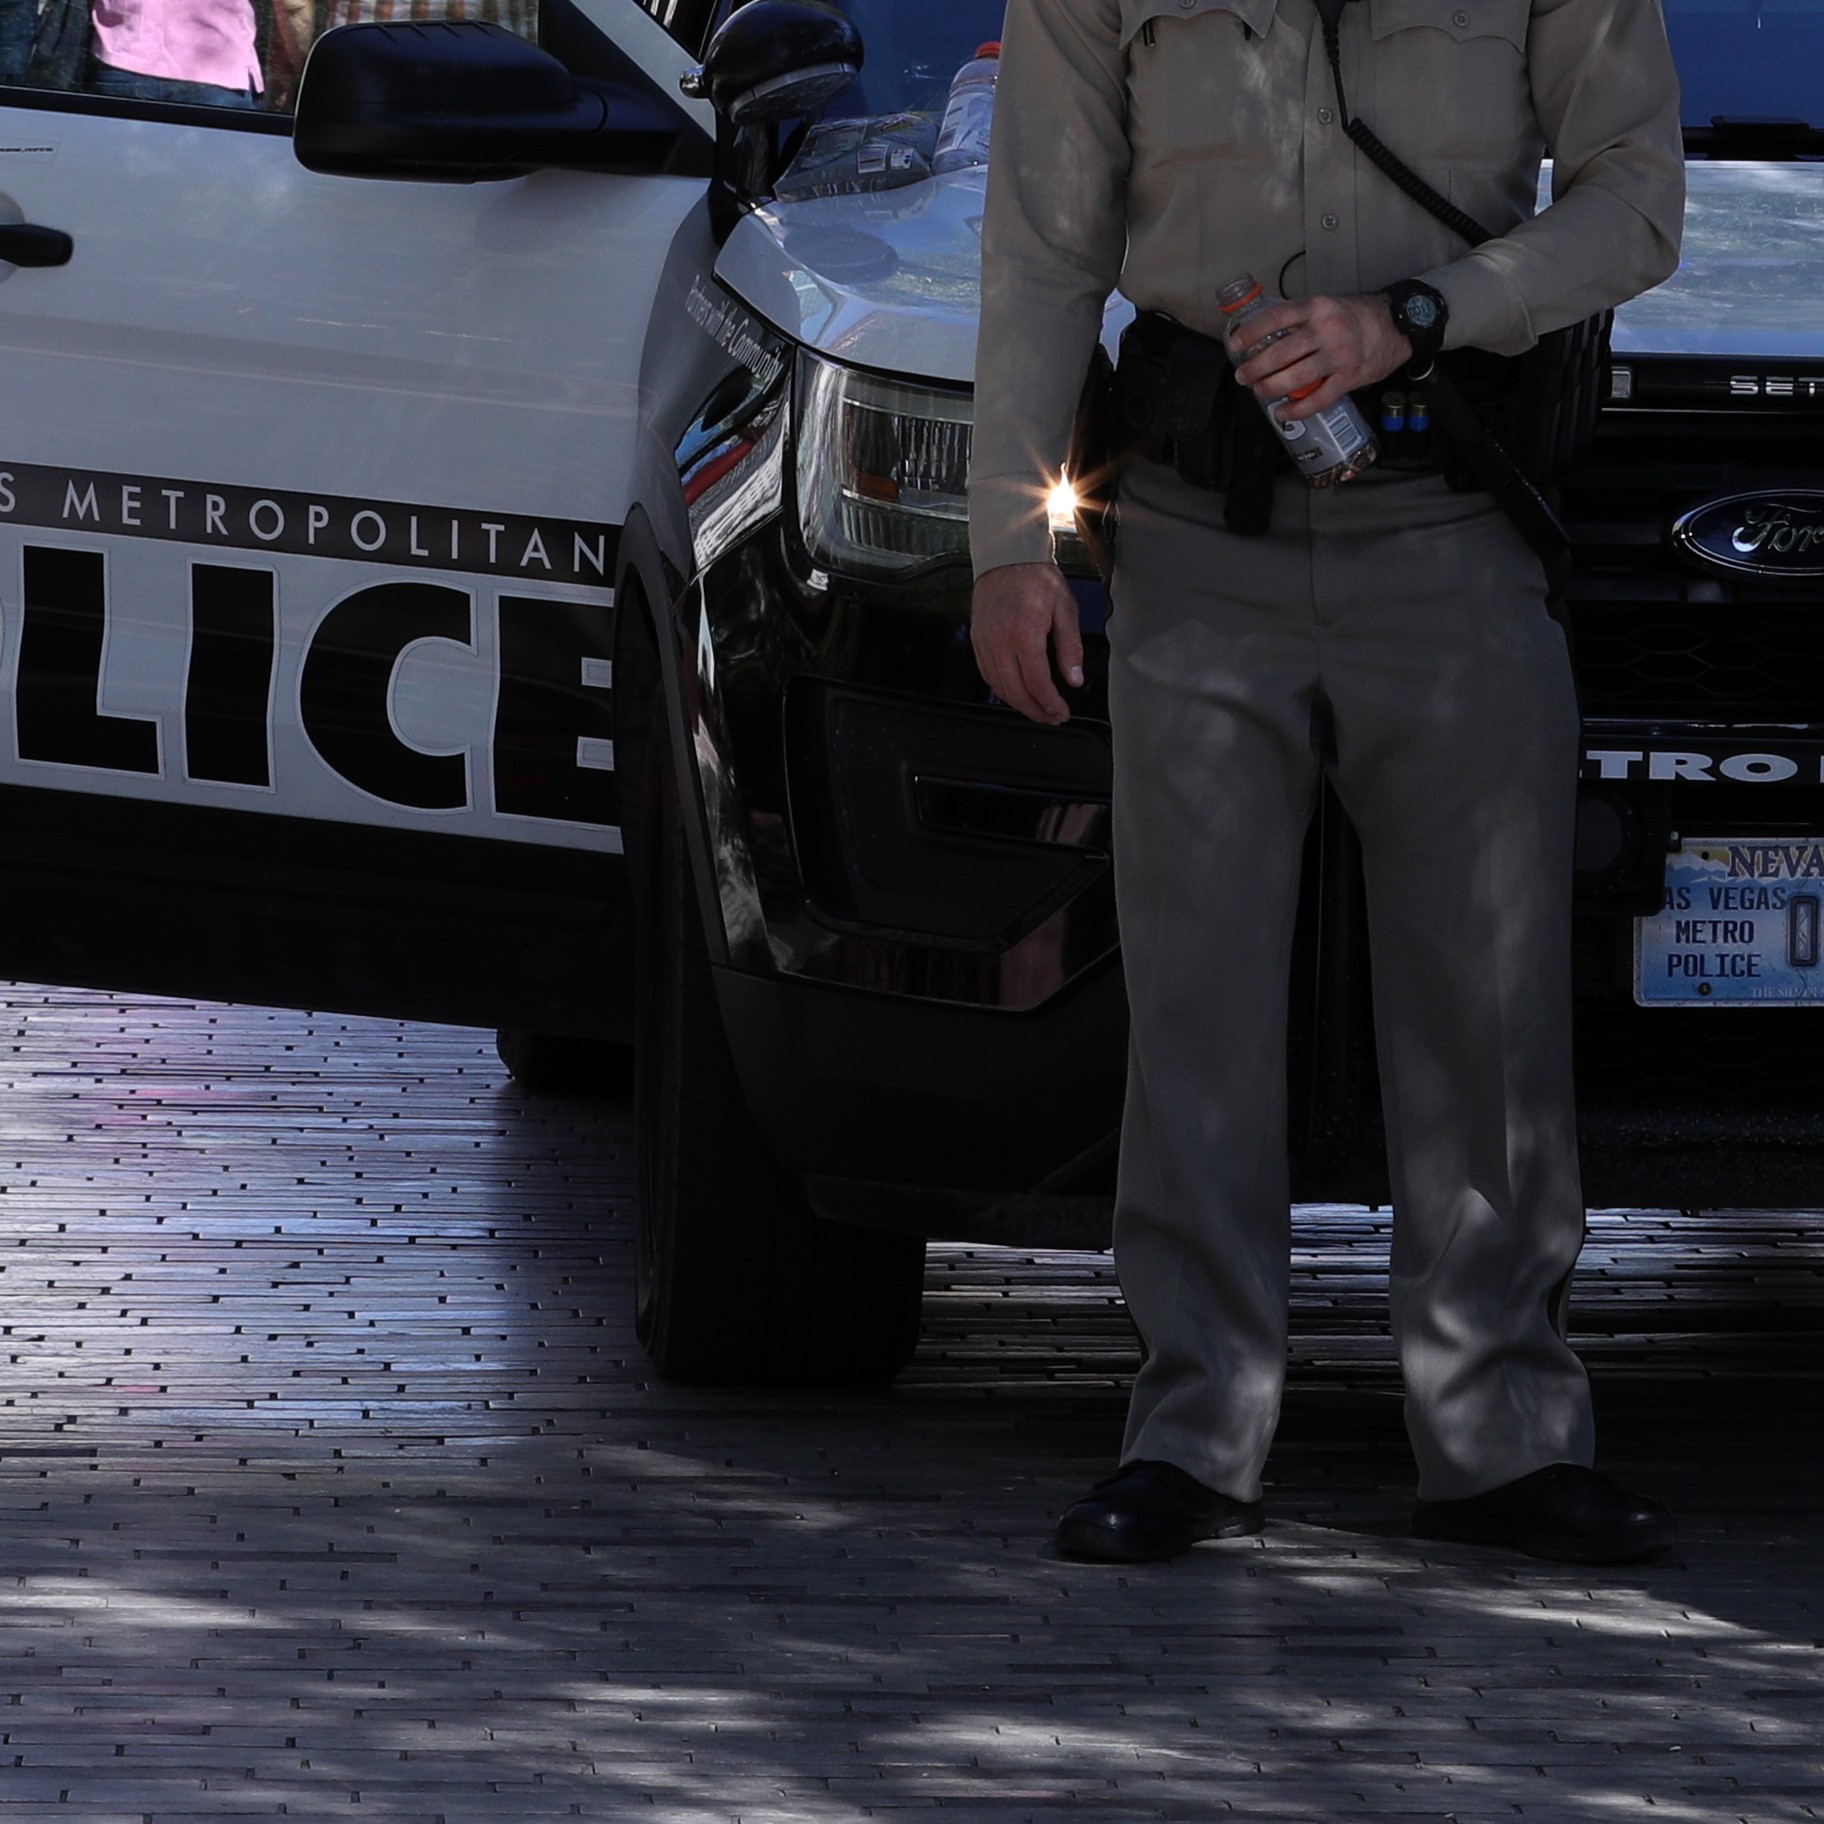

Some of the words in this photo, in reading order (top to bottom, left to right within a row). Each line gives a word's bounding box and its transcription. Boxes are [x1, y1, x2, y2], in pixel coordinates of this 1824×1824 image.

[728, 318, 784, 395] Community
[61, 479, 605, 576] METROPOLITAN
[1585, 749, 1799, 783] TRO
[1664, 886, 1691, 911] AS
[1709, 886, 1787, 911] VEGAS
[1675, 919, 1755, 944] METRO
[1667, 953, 1762, 978] POLICE
[1751, 986, 1776, 998] THE
[1778, 987, 1817, 999] SILVER
